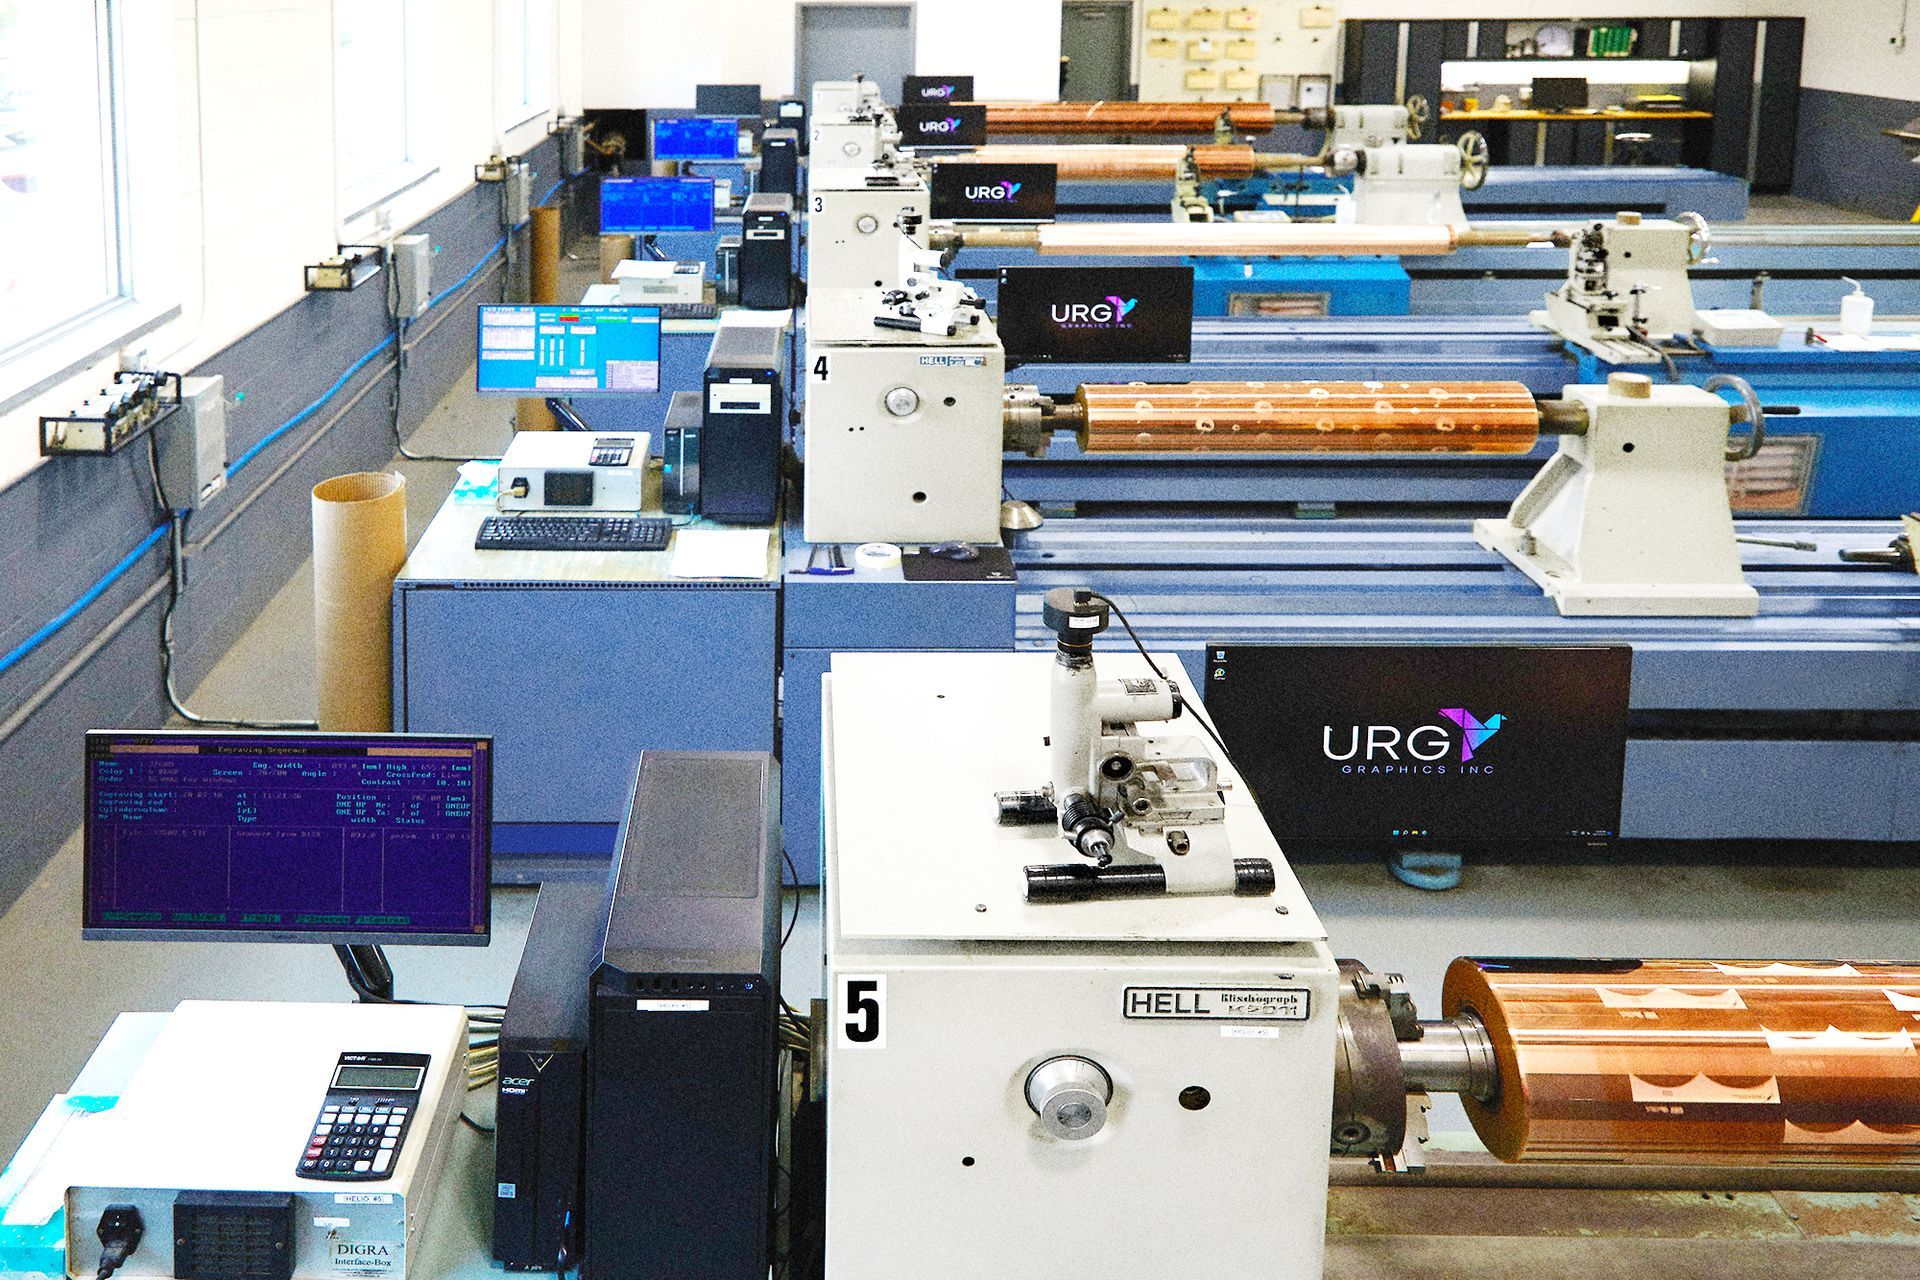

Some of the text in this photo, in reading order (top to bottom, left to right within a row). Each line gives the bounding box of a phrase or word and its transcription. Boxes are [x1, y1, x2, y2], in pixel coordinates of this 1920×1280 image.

[919, 120, 950, 133] URG
[814, 130, 820, 140] 2
[965, 186, 1006, 200] URG
[815, 197, 823, 212] 3
[1051, 304, 1112, 323] URG
[920, 356, 947, 365] HELL
[813, 355, 829, 381] 4
[1322, 725, 1451, 761] URG
[1341, 765, 1494, 774] GRAPHICS INC
[1131, 993, 1298, 1014] HELL Klischograph
[845, 980, 879, 1042] 5
[502, 1077, 535, 1086] acer
[337, 1244, 389, 1255] DIGRA
[335, 1258, 392, 1267] Interface-Box
